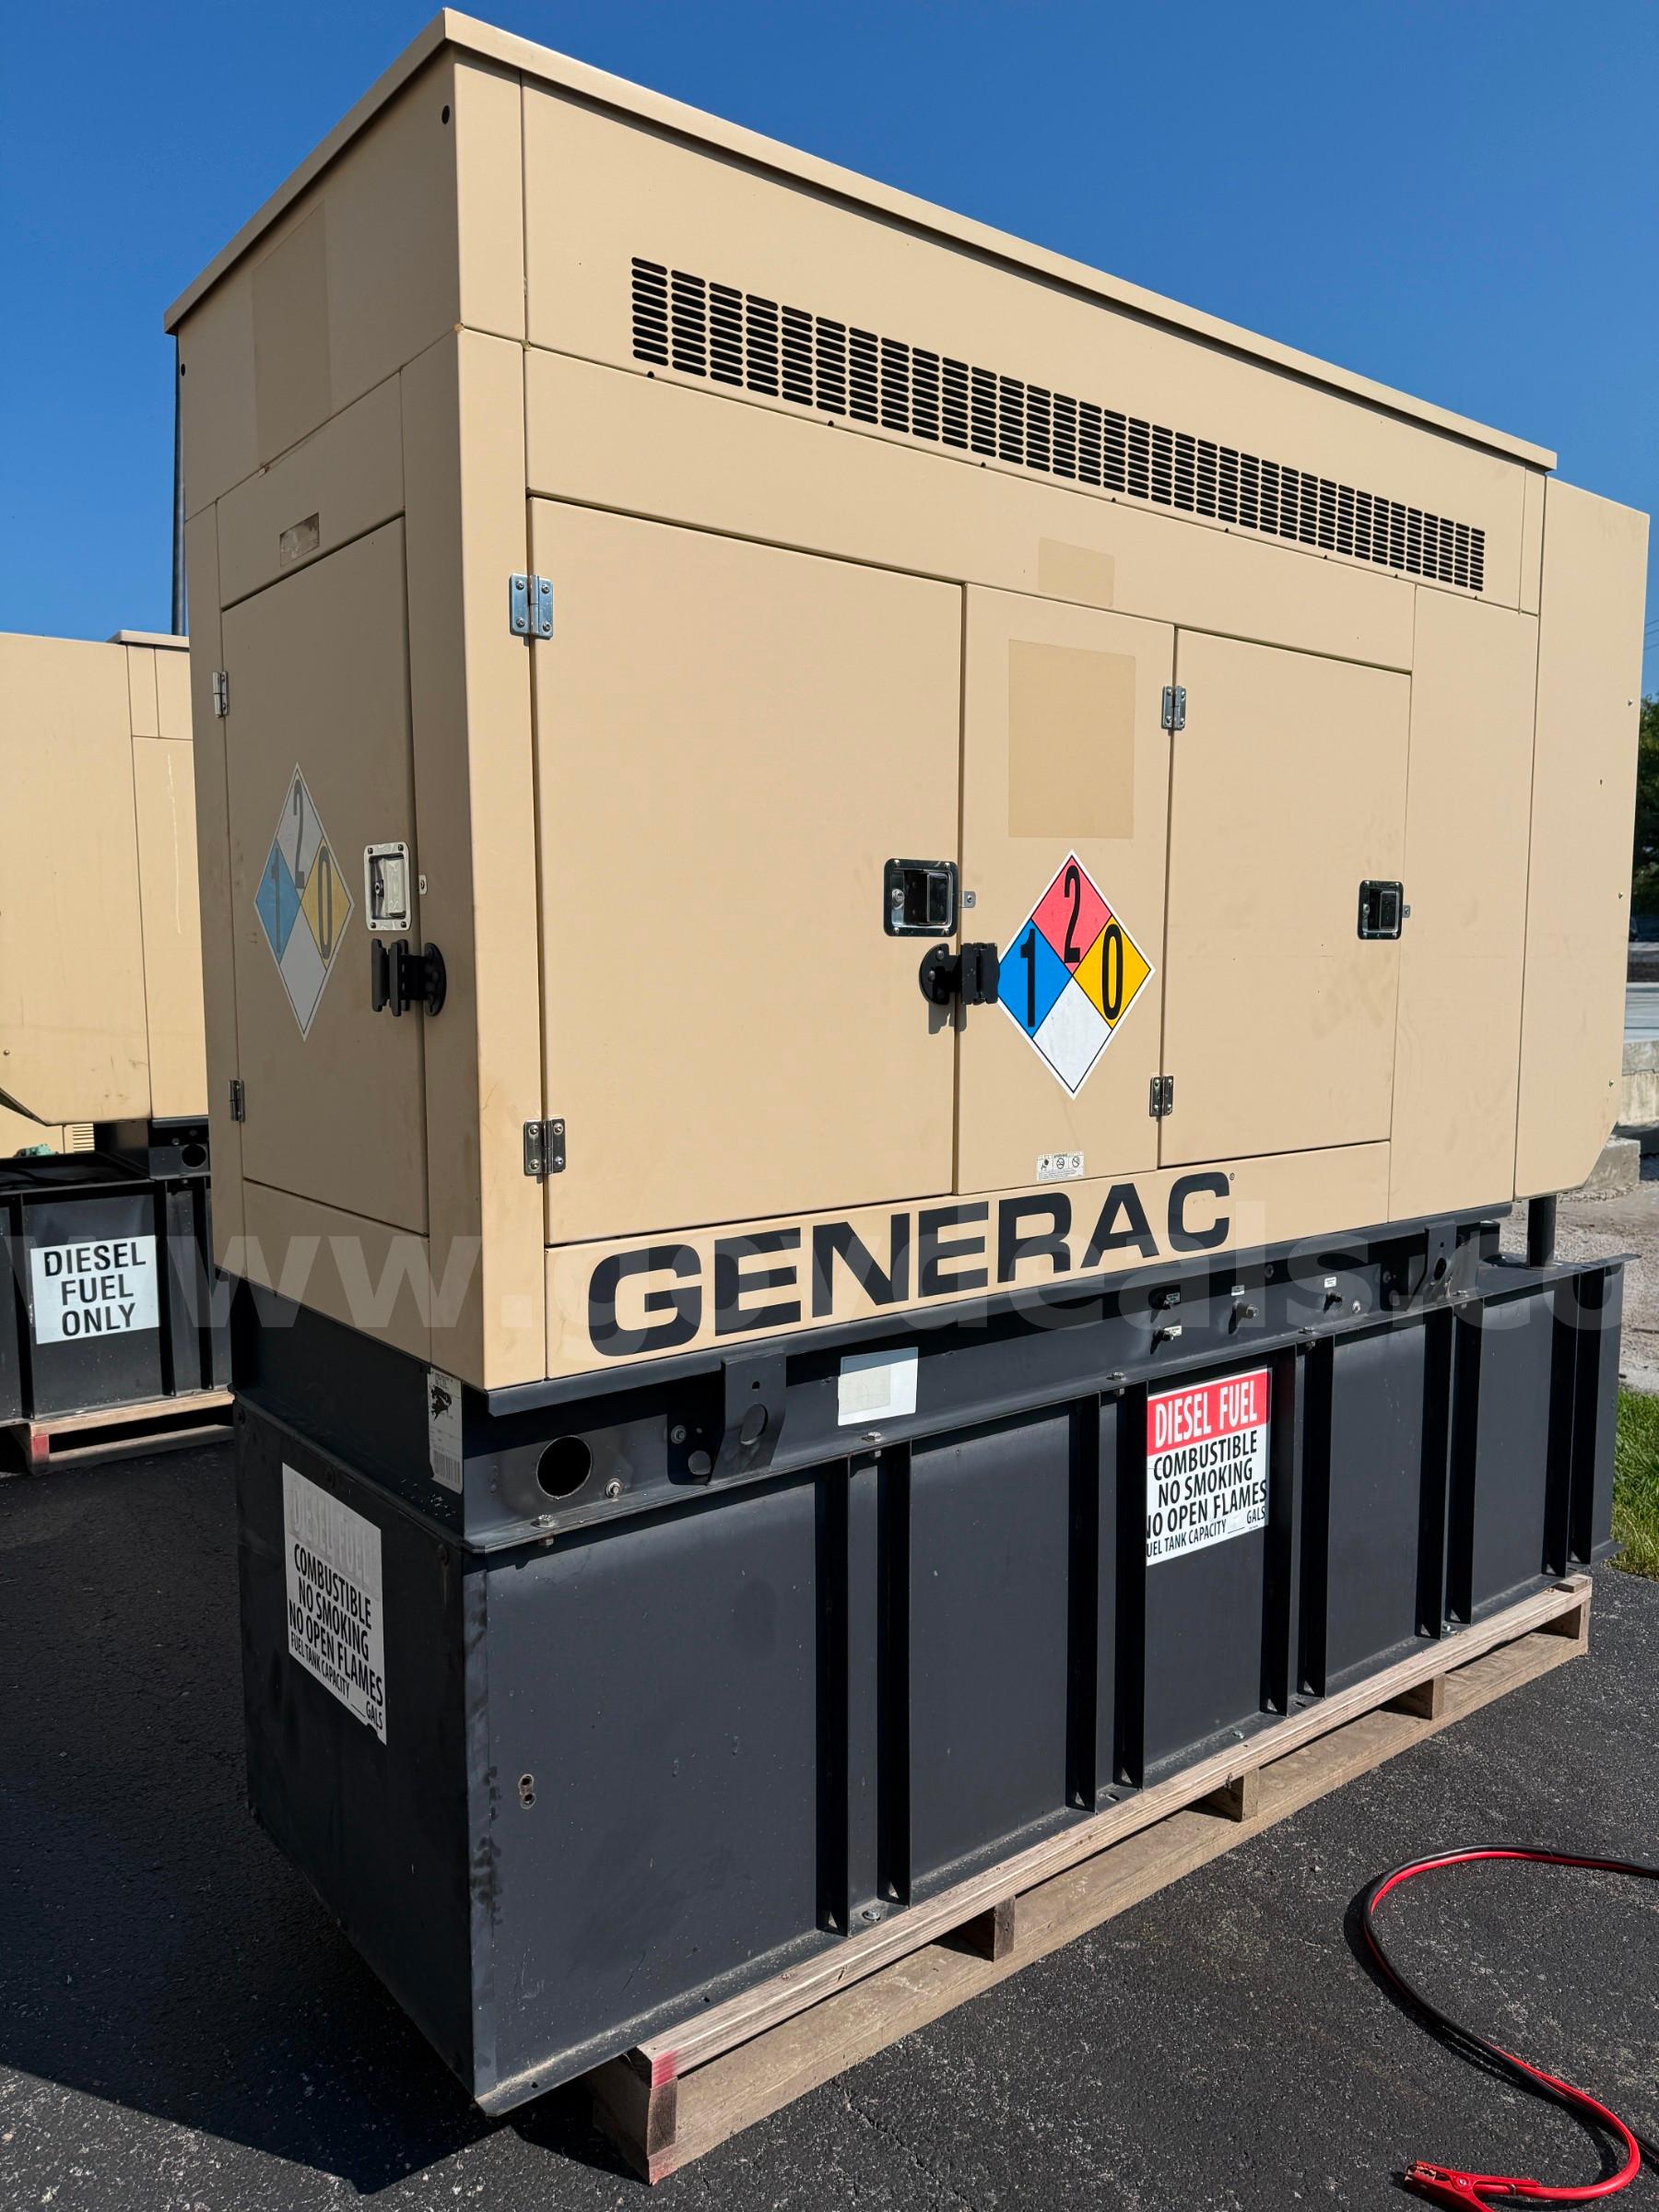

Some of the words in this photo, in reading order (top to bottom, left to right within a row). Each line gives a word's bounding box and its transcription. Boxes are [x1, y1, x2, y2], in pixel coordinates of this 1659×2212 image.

[293, 779, 305, 889] 2
[271, 845, 281, 955] 1
[318, 845, 333, 959] 0
[1064, 865, 1081, 963] 2
[1019, 928, 1036, 1028] 1
[1101, 924, 1124, 1021] 0
[44, 1241, 147, 1277] DIESEL
[61, 1273, 135, 1306] FUEL
[588, 1171, 1232, 1357] GENERAC
[62, 1302, 136, 1337] ONLY
[1154, 1430, 1258, 1481] COMBUSTIBLE
[1155, 1392, 1212, 1449] DIESEL
[1219, 1381, 1258, 1430] FUEL
[1159, 1479, 1181, 1509] NO
[1184, 1457, 1253, 1500] SMOKING
[1168, 1499, 1207, 1533] OPEN
[1214, 1479, 1267, 1521] FLAMES
[1147, 1540, 1162, 1558] UEL
[1165, 1532, 1187, 1552] TANK
[1188, 1519, 1227, 1545] CAPACITY
[1246, 1504, 1265, 1524] GALS
[294, 1543, 372, 1630] COMBUSTIBLE
[298, 1575, 313, 1613] NO
[316, 1592, 370, 1662] SMOKING
[288, 1599, 304, 1636] NO
[306, 1615, 335, 1665] OPEN
[337, 1641, 383, 1708] FLAMES
[290, 1631, 305, 1658] FUEL
[305, 1643, 322, 1674] TANK
[322, 1660, 350, 1700] CAPACITY
[366, 1700, 383, 1731] GALS
